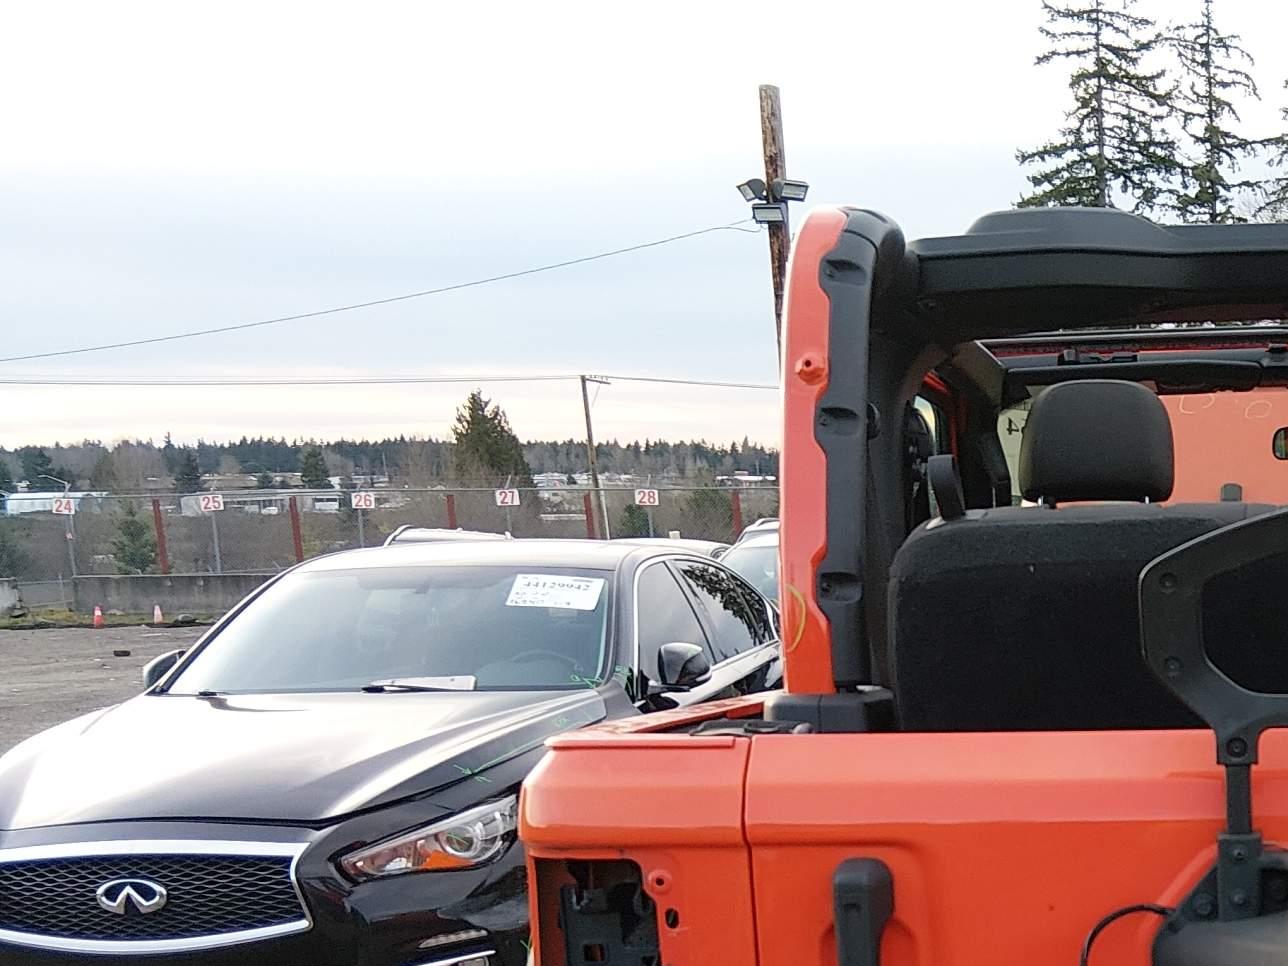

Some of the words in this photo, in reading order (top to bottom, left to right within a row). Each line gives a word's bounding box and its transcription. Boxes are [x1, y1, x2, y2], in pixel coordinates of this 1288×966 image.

[202, 495, 221, 510] 25
[354, 494, 372, 507] 26
[499, 490, 516, 504] 27
[639, 490, 656, 504] 28
[55, 499, 73, 513] 24
